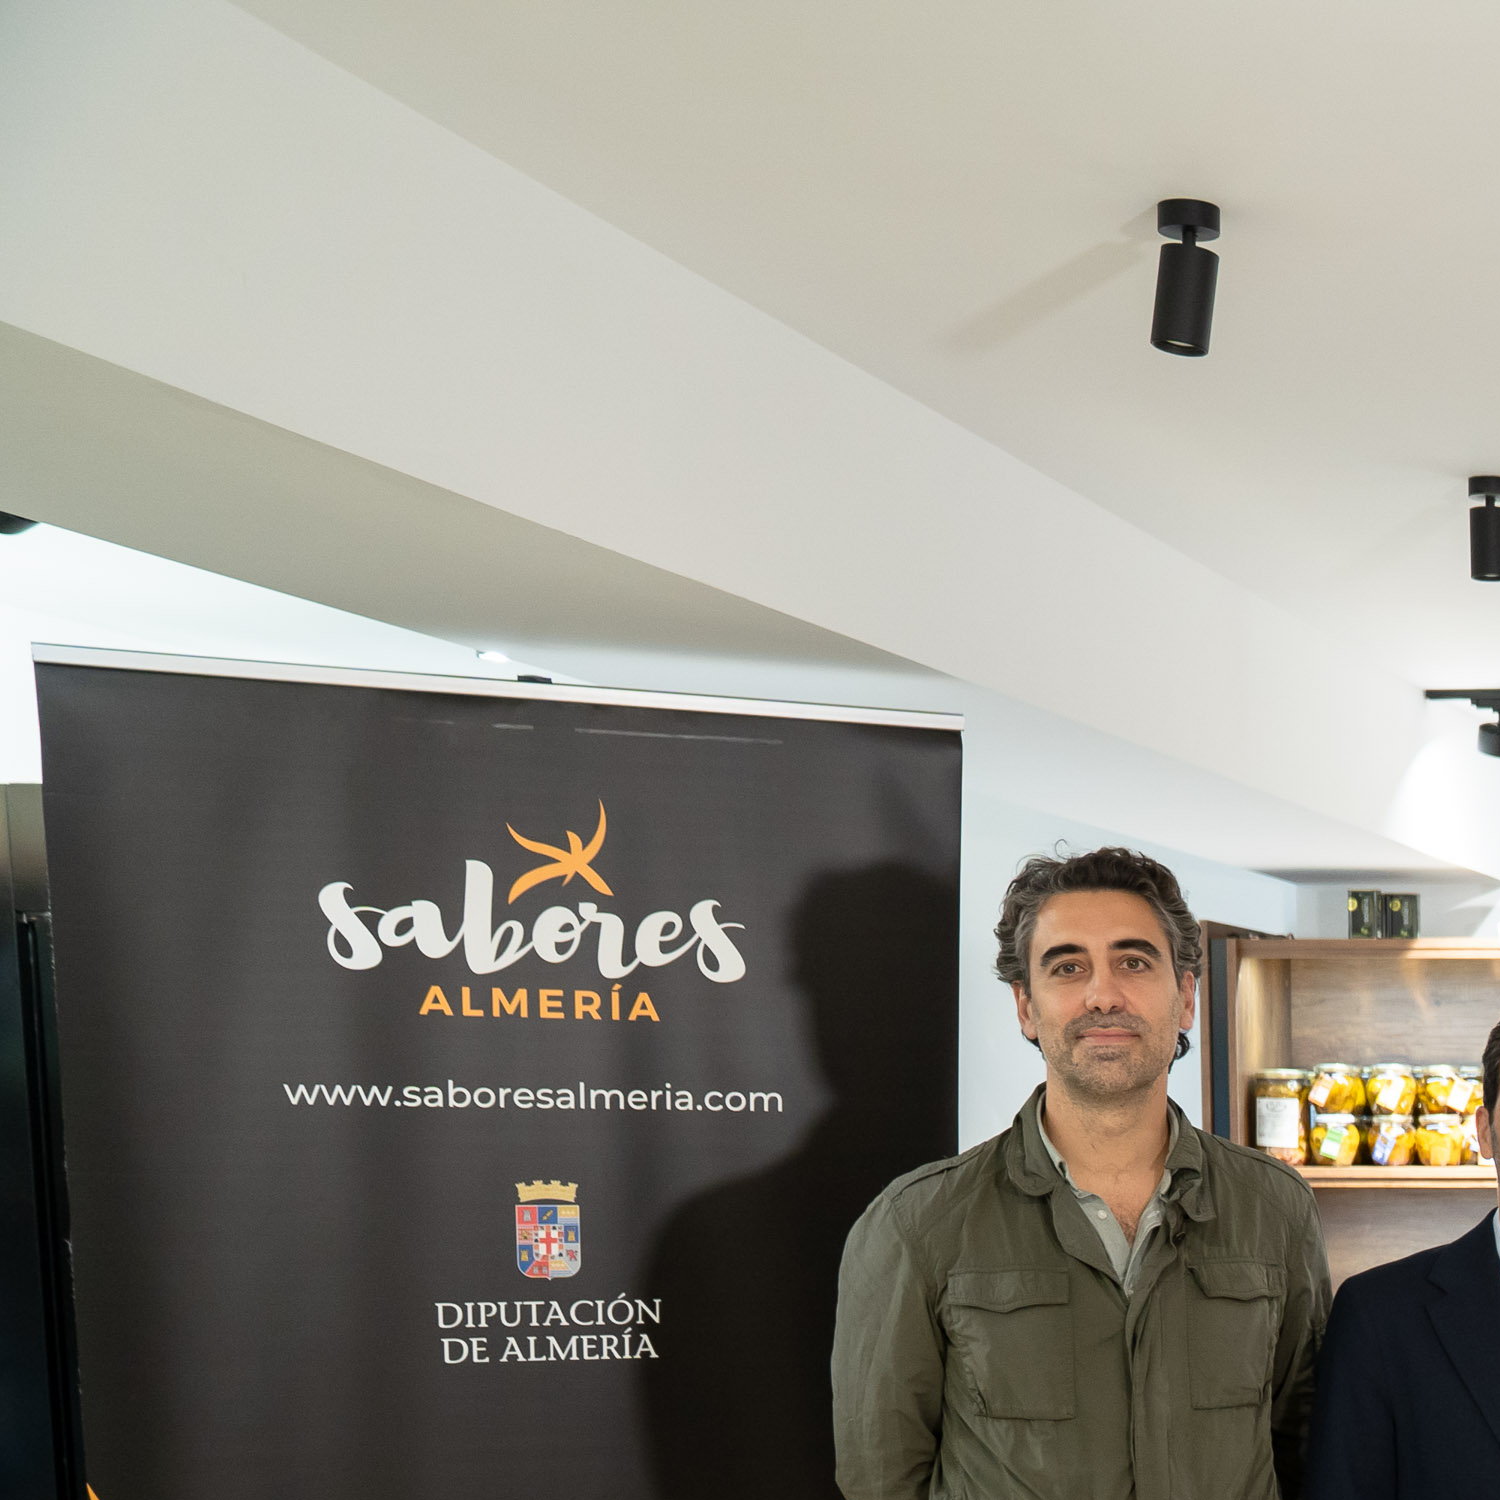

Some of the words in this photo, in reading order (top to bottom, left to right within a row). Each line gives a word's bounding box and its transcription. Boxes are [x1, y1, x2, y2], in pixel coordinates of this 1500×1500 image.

[418, 983, 661, 1023] ALMERÍA
[282, 1079, 784, 1114] www.saboresalmeria.com
[434, 1292, 662, 1329] DIPUTACIÓN
[440, 1337, 490, 1364] DE
[499, 1327, 659, 1363] ALMERÍA
